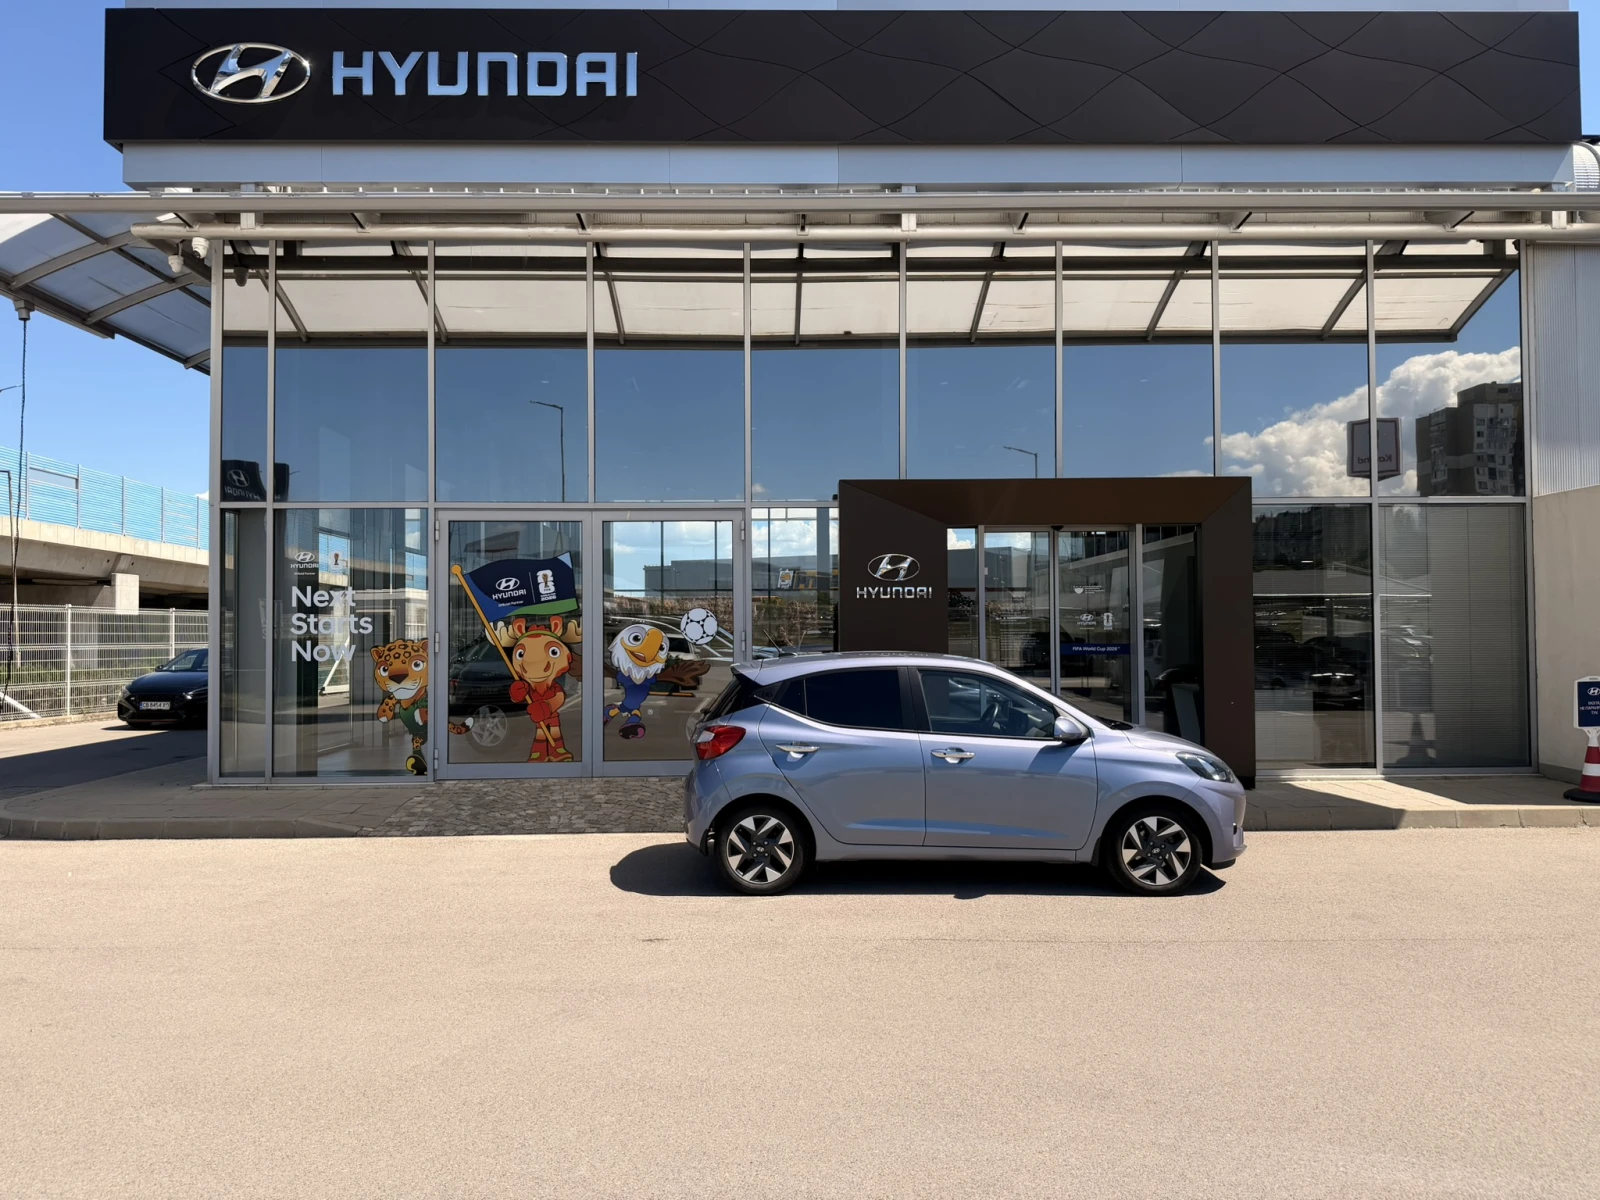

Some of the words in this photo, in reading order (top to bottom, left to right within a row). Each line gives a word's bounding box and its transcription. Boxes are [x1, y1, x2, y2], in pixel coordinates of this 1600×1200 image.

[332, 50, 638, 97] HYUNDAI
[292, 586, 356, 607] Next
[492, 589, 526, 600] HYUNDAI
[856, 587, 932, 598] HYUNDAI
[290, 613, 373, 634] Starts
[292, 640, 356, 662] Now
